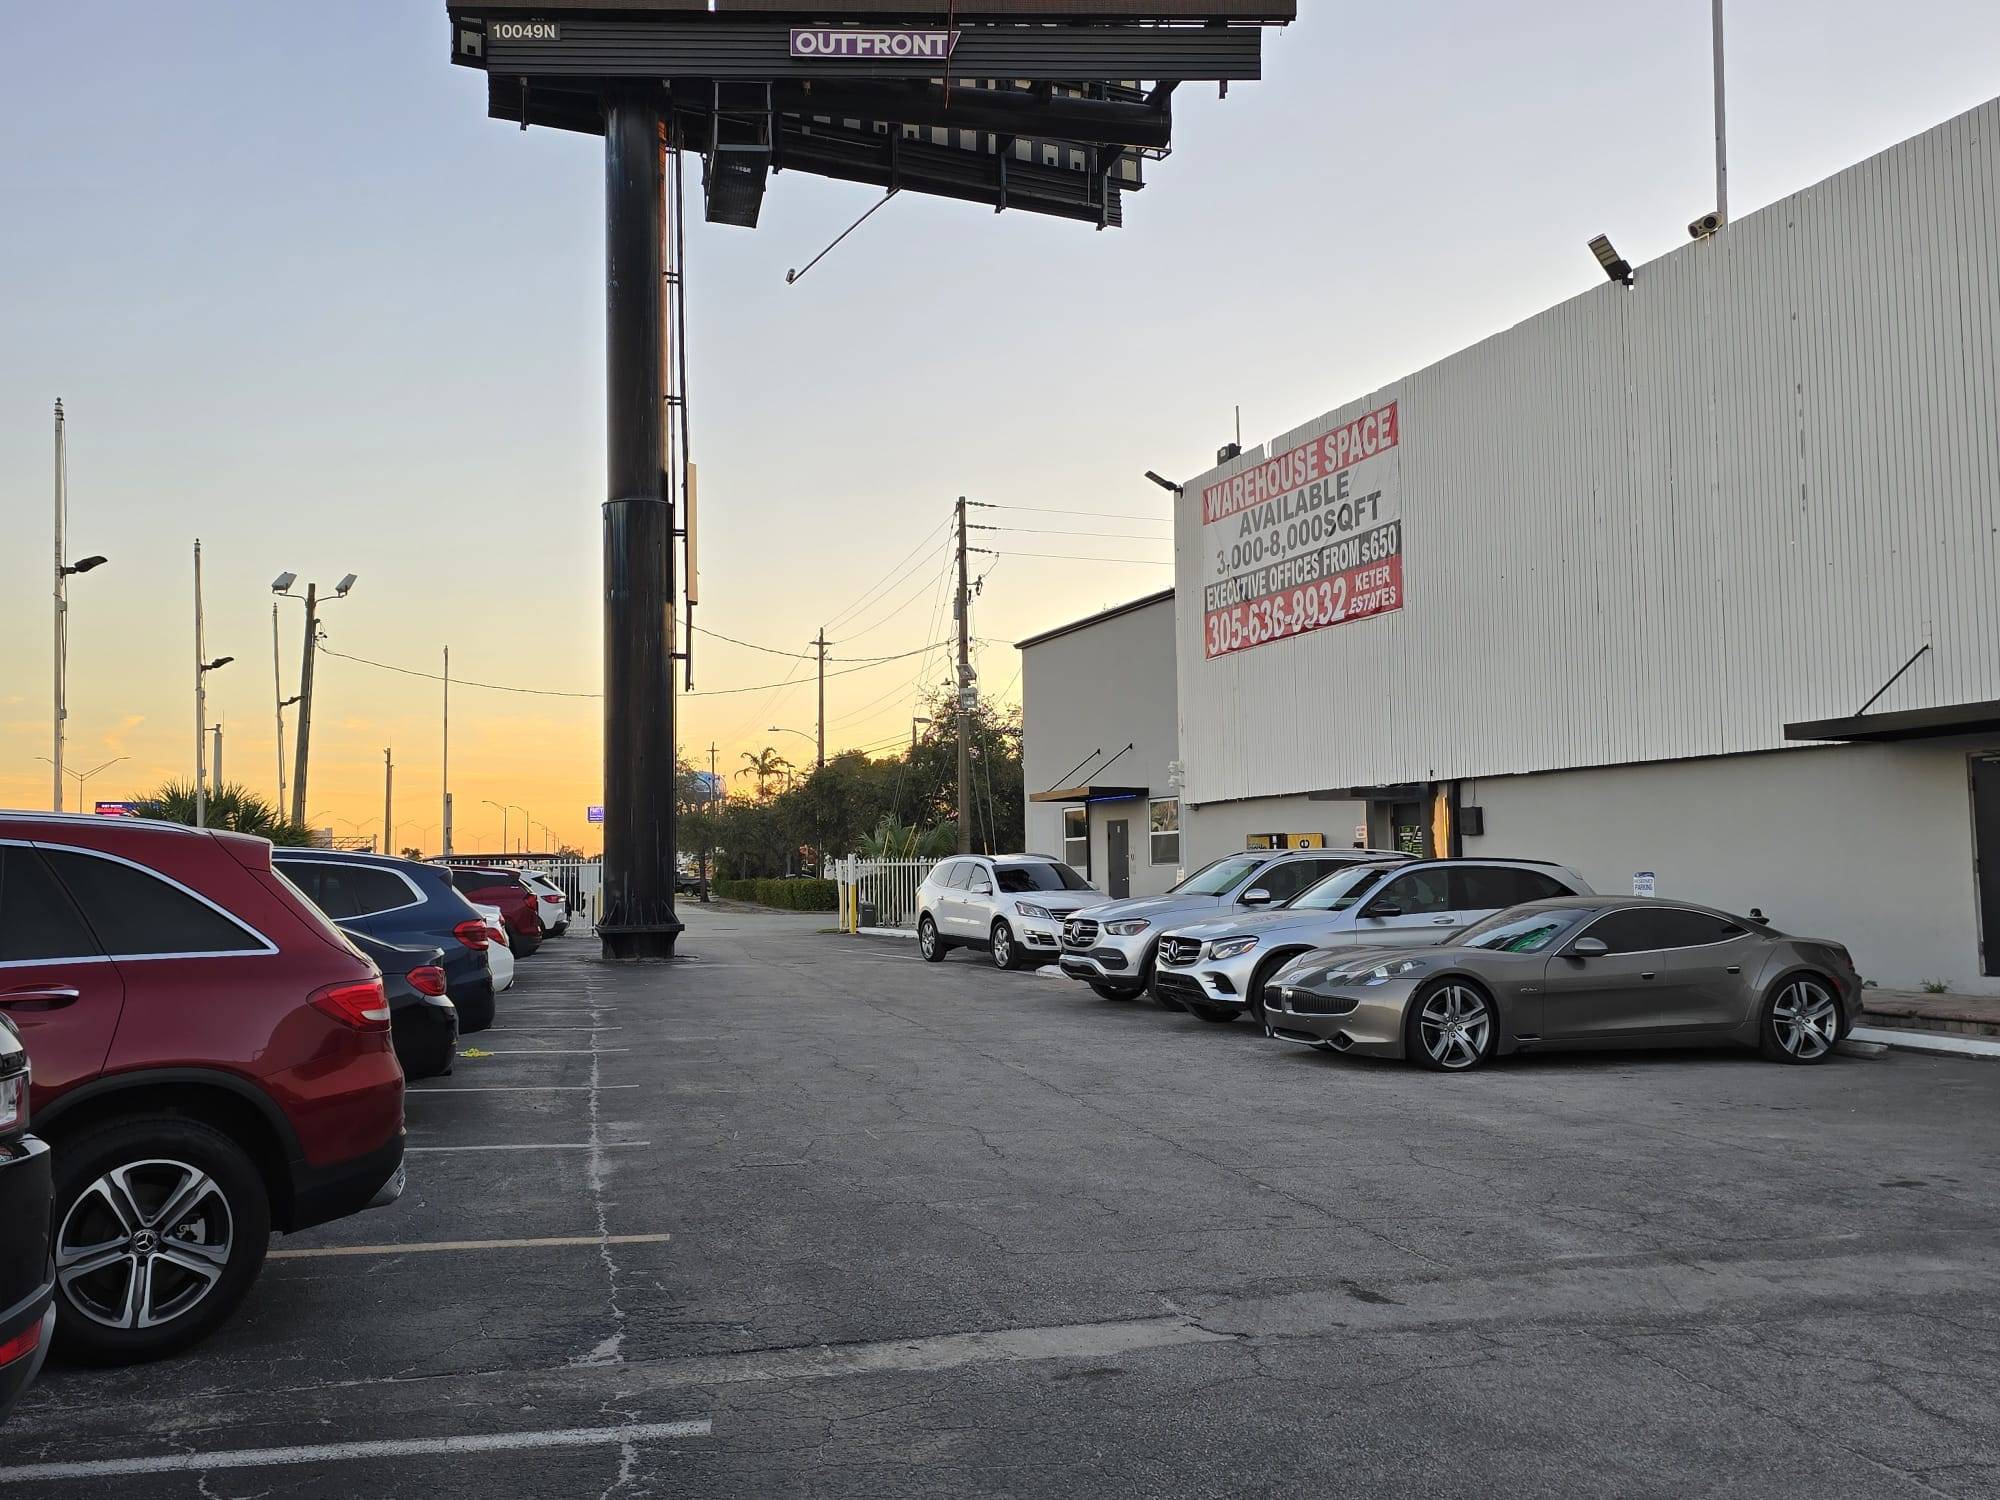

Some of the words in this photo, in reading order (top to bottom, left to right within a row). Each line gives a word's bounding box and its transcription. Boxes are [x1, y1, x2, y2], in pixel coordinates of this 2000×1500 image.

[493, 24, 556, 39] 10049N
[796, 32, 948, 55] OUTFRONT
[1207, 443, 1318, 522] WAREHOUSE
[1324, 408, 1391, 473] SPACE
[1217, 490, 1381, 577] 3,000-8,000SQFT
[1239, 471, 1349, 538] AVAILABLE
[1207, 572, 1267, 612] EXECUTIVE
[1270, 552, 1319, 592] OFFICES
[1323, 538, 1359, 577] FROM
[1361, 525, 1397, 563] $650
[1349, 587, 1396, 615] ESTATES
[1355, 565, 1390, 592] KETER
[1209, 576, 1347, 655] 305-636-8932
